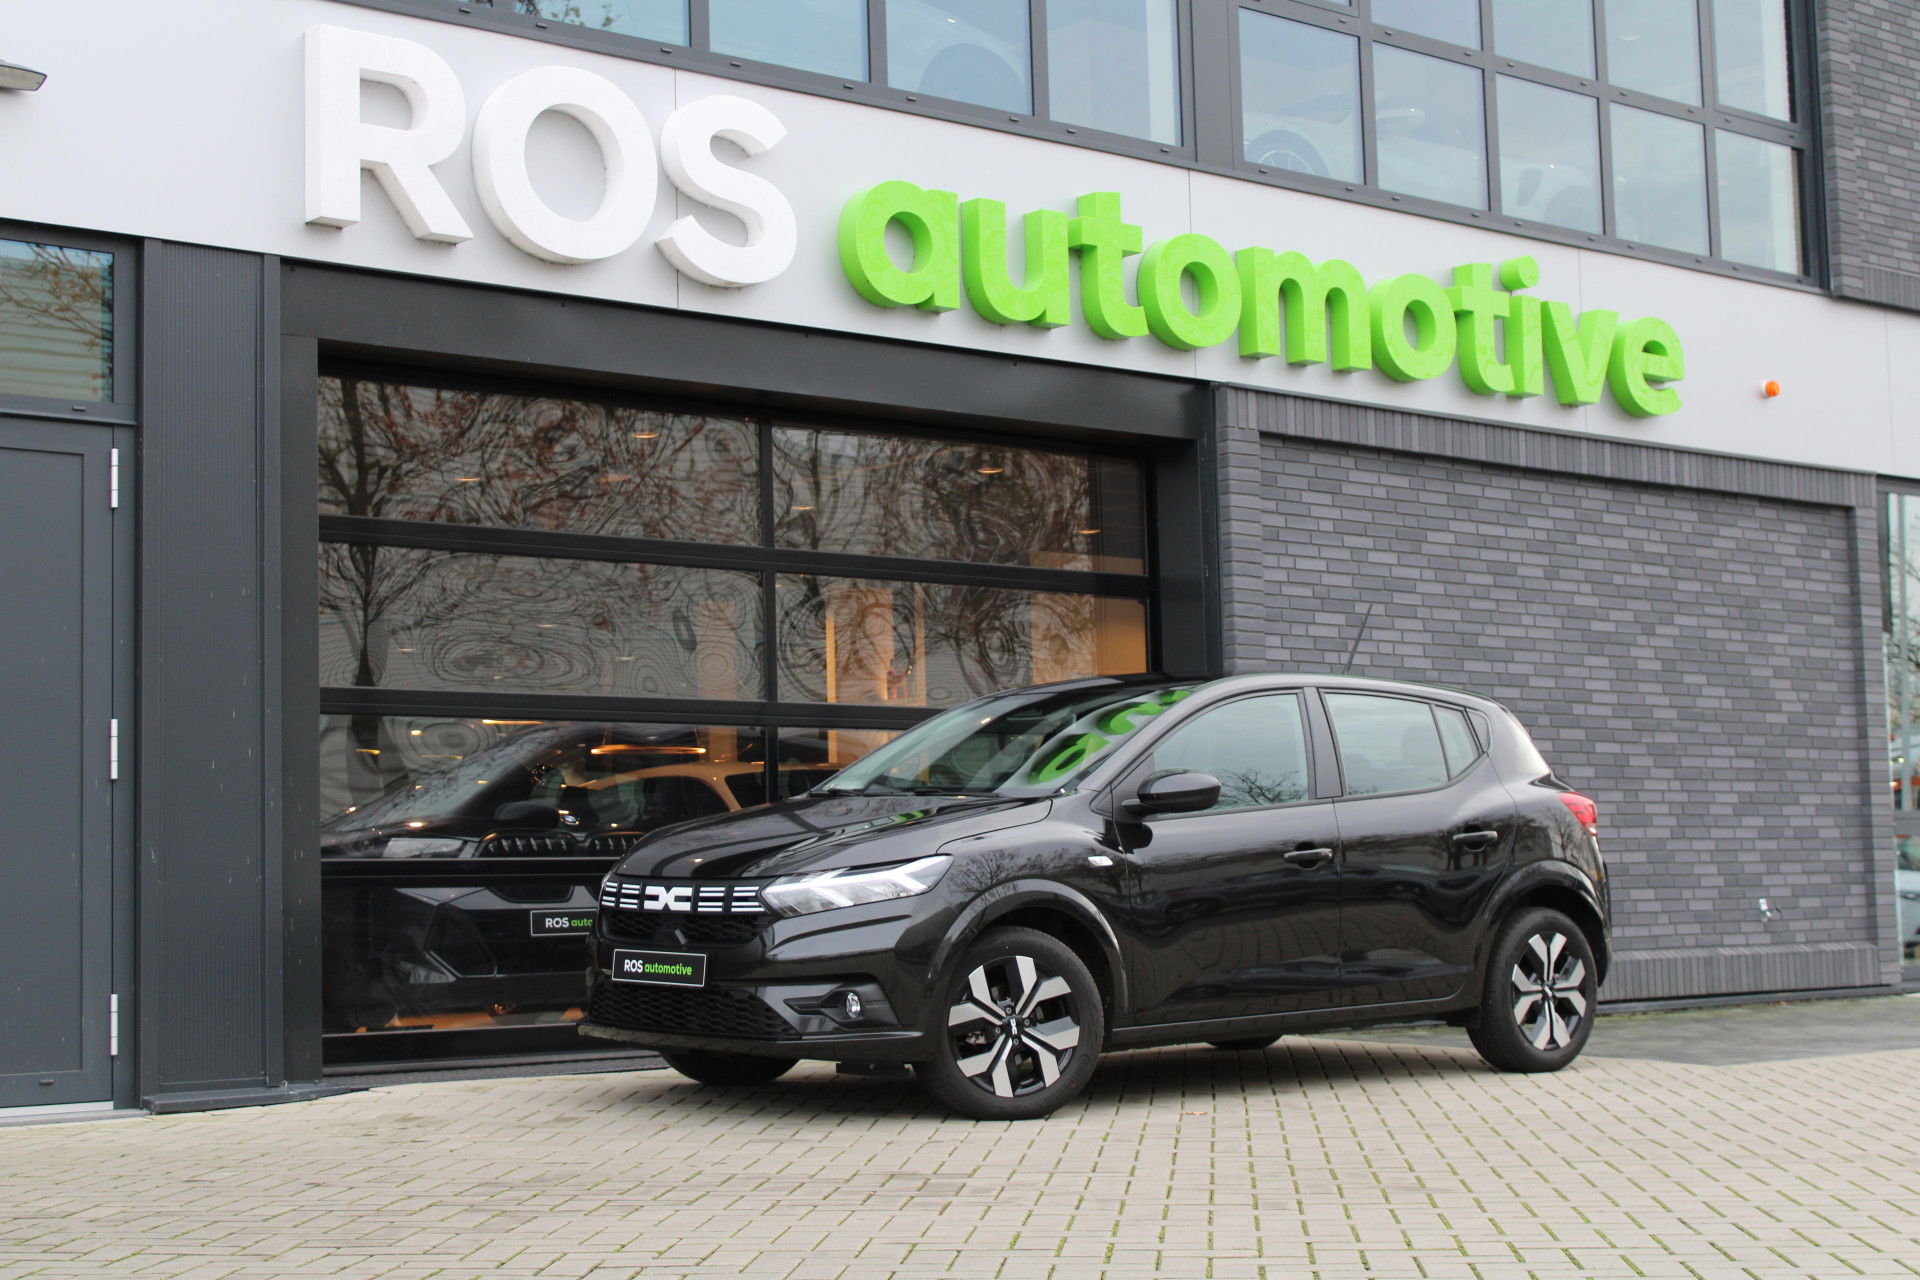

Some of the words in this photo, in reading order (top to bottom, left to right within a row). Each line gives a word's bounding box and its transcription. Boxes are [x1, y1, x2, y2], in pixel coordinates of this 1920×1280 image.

[303, 24, 798, 288] ROS
[837, 180, 1686, 418] automotive
[545, 917, 569, 928] ROS
[624, 959, 643, 973] ROS
[644, 963, 693, 976] automotive
